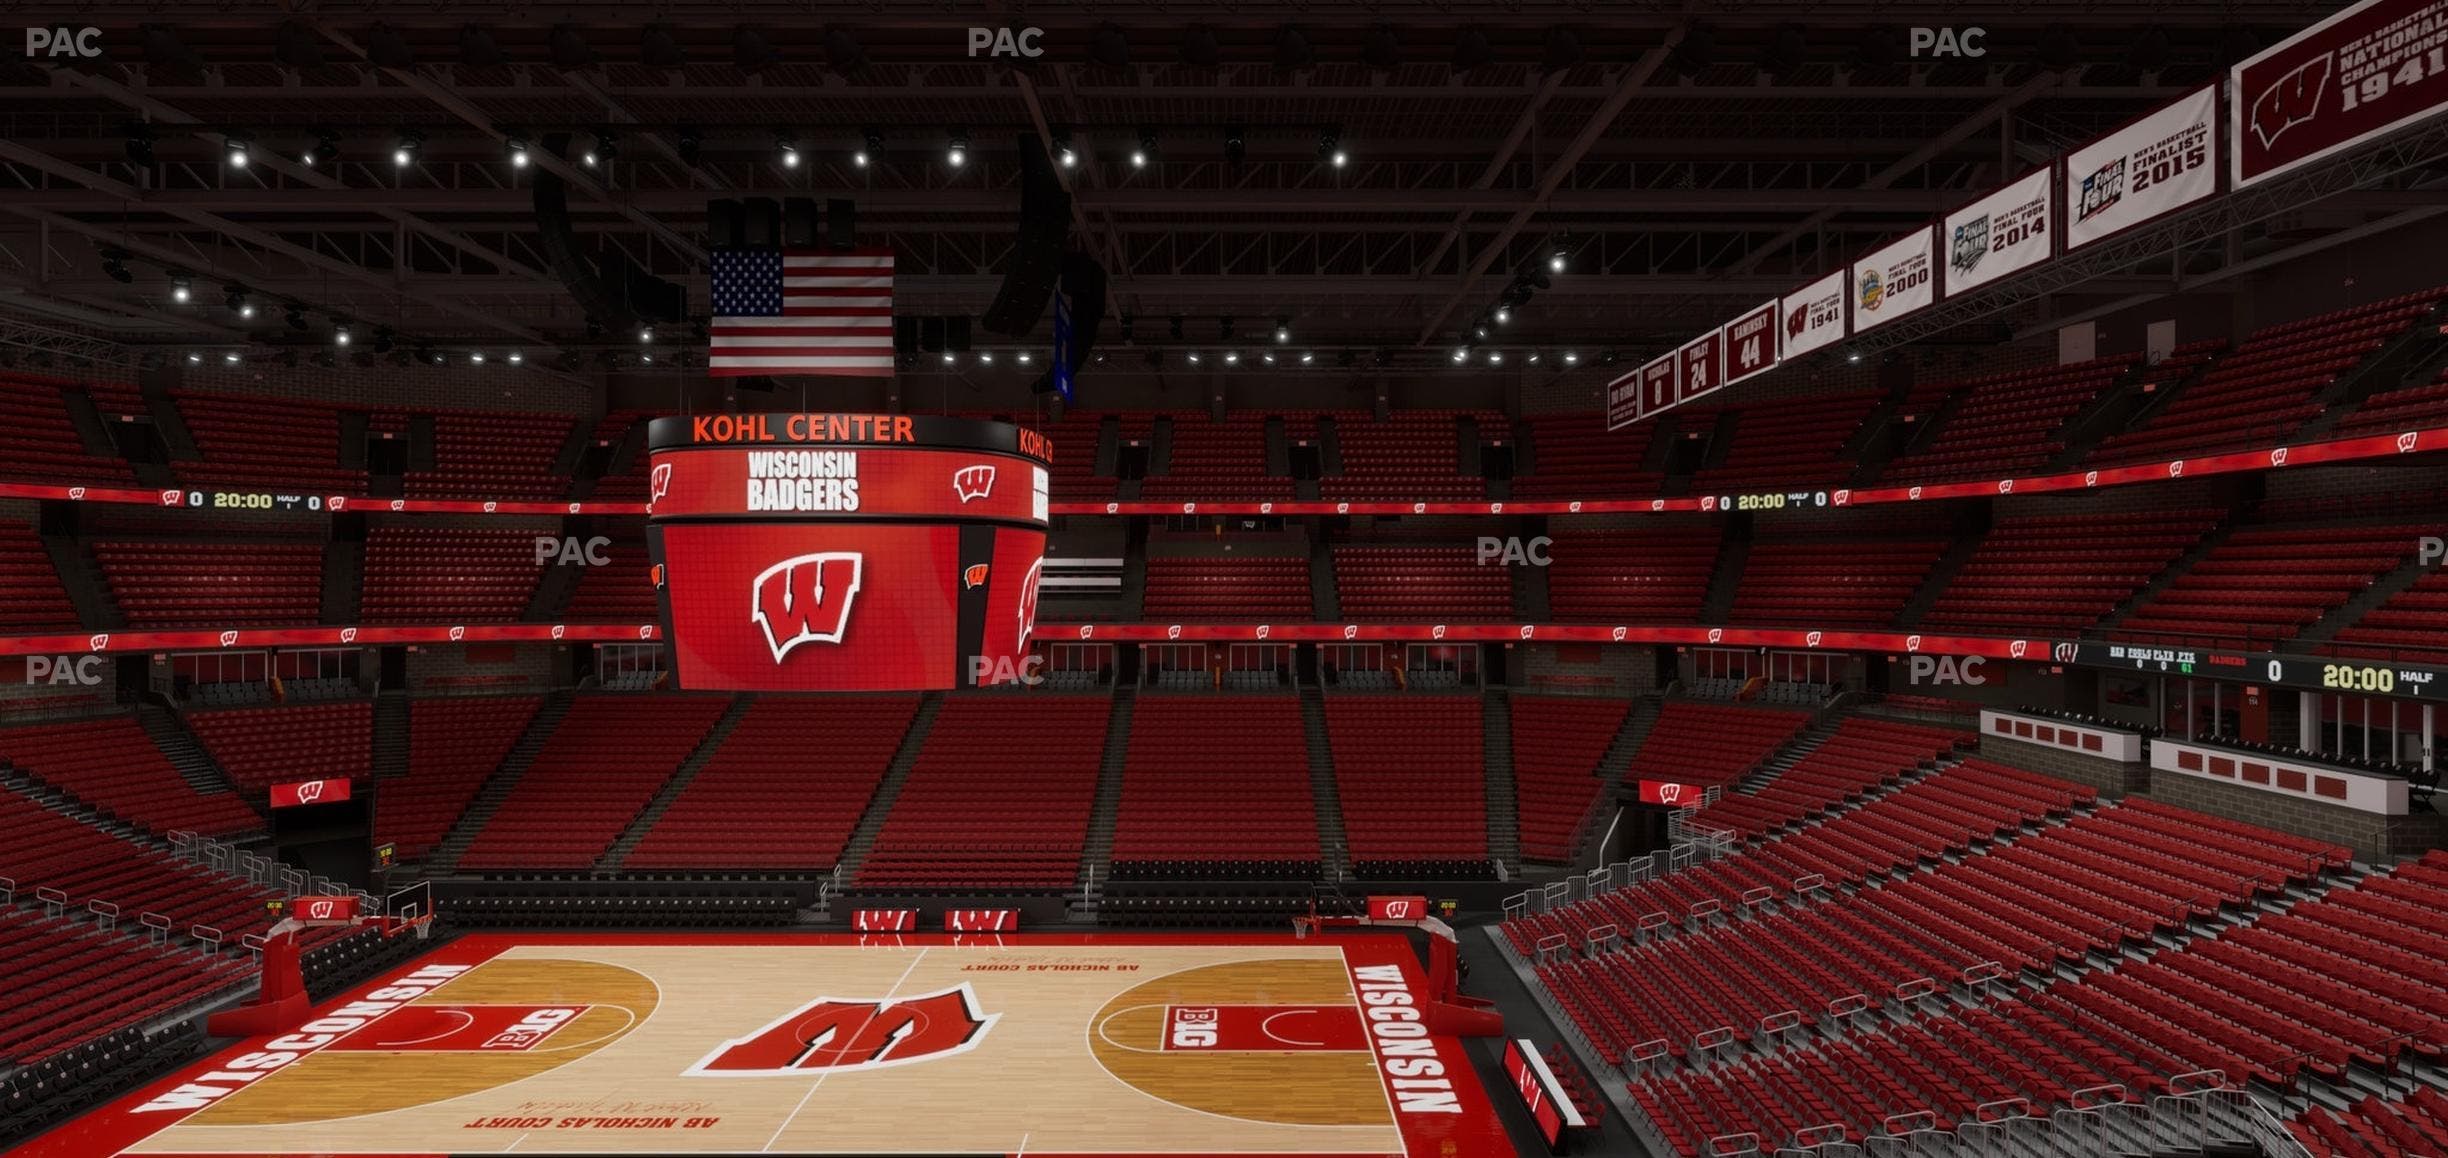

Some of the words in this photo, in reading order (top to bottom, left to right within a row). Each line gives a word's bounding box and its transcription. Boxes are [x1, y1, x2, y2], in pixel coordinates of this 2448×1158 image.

[2340, 12, 2448, 73] NATIONAL
[2341, 29, 2448, 86] CHAMPIONS
[2342, 46, 2446, 112] 1941
[2250, 50, 2334, 150] W
[2157, 121, 2206, 148] BASKETBALL
[2133, 130, 2207, 173] FINALIST
[2132, 145, 2205, 194] 2015
[1993, 217, 2018, 233] FINAL
[2021, 204, 2045, 223] FOUR
[1992, 216, 2045, 253] 2014
[1886, 268, 1928, 298] 2000
[1811, 307, 1839, 330] 1941
[1740, 335, 1760, 369] 44
[1690, 359, 1707, 391] 24
[693, 416, 774, 442] KOHL
[786, 414, 916, 442] CENTER
[1019, 427, 1045, 459] KOHL
[747, 451, 857, 479] WISCONSIN
[747, 478, 860, 512] BADGERS
[954, 465, 996, 503] W
[190, 491, 203, 507] 0
[214, 492, 273, 509] 20:00
[308, 496, 321, 511] 0
[1720, 496, 1731, 511] 0
[1738, 494, 1785, 510] 20:00
[1815, 491, 1827, 507] 0
[752, 552, 863, 665] W
[2268, 660, 2282, 682] 0
[2323, 664, 2394, 693] 20:00
[2400, 671, 2433, 683] HALF
[297, 780, 324, 804] W
[310, 901, 334, 919] W
[1386, 901, 1409, 919] W
[960, 964, 1021, 972] COURT
[1026, 964, 1110, 972] NICHOLAS
[1117, 964, 1140, 972] AB
[128, 964, 473, 1114] WISCONSIN
[1354, 964, 1463, 1114] WISCONSIN
[463, 1116, 554, 1129] COURT
[556, 1116, 679, 1129] NICHOLAS
[683, 1116, 720, 1129] AB
